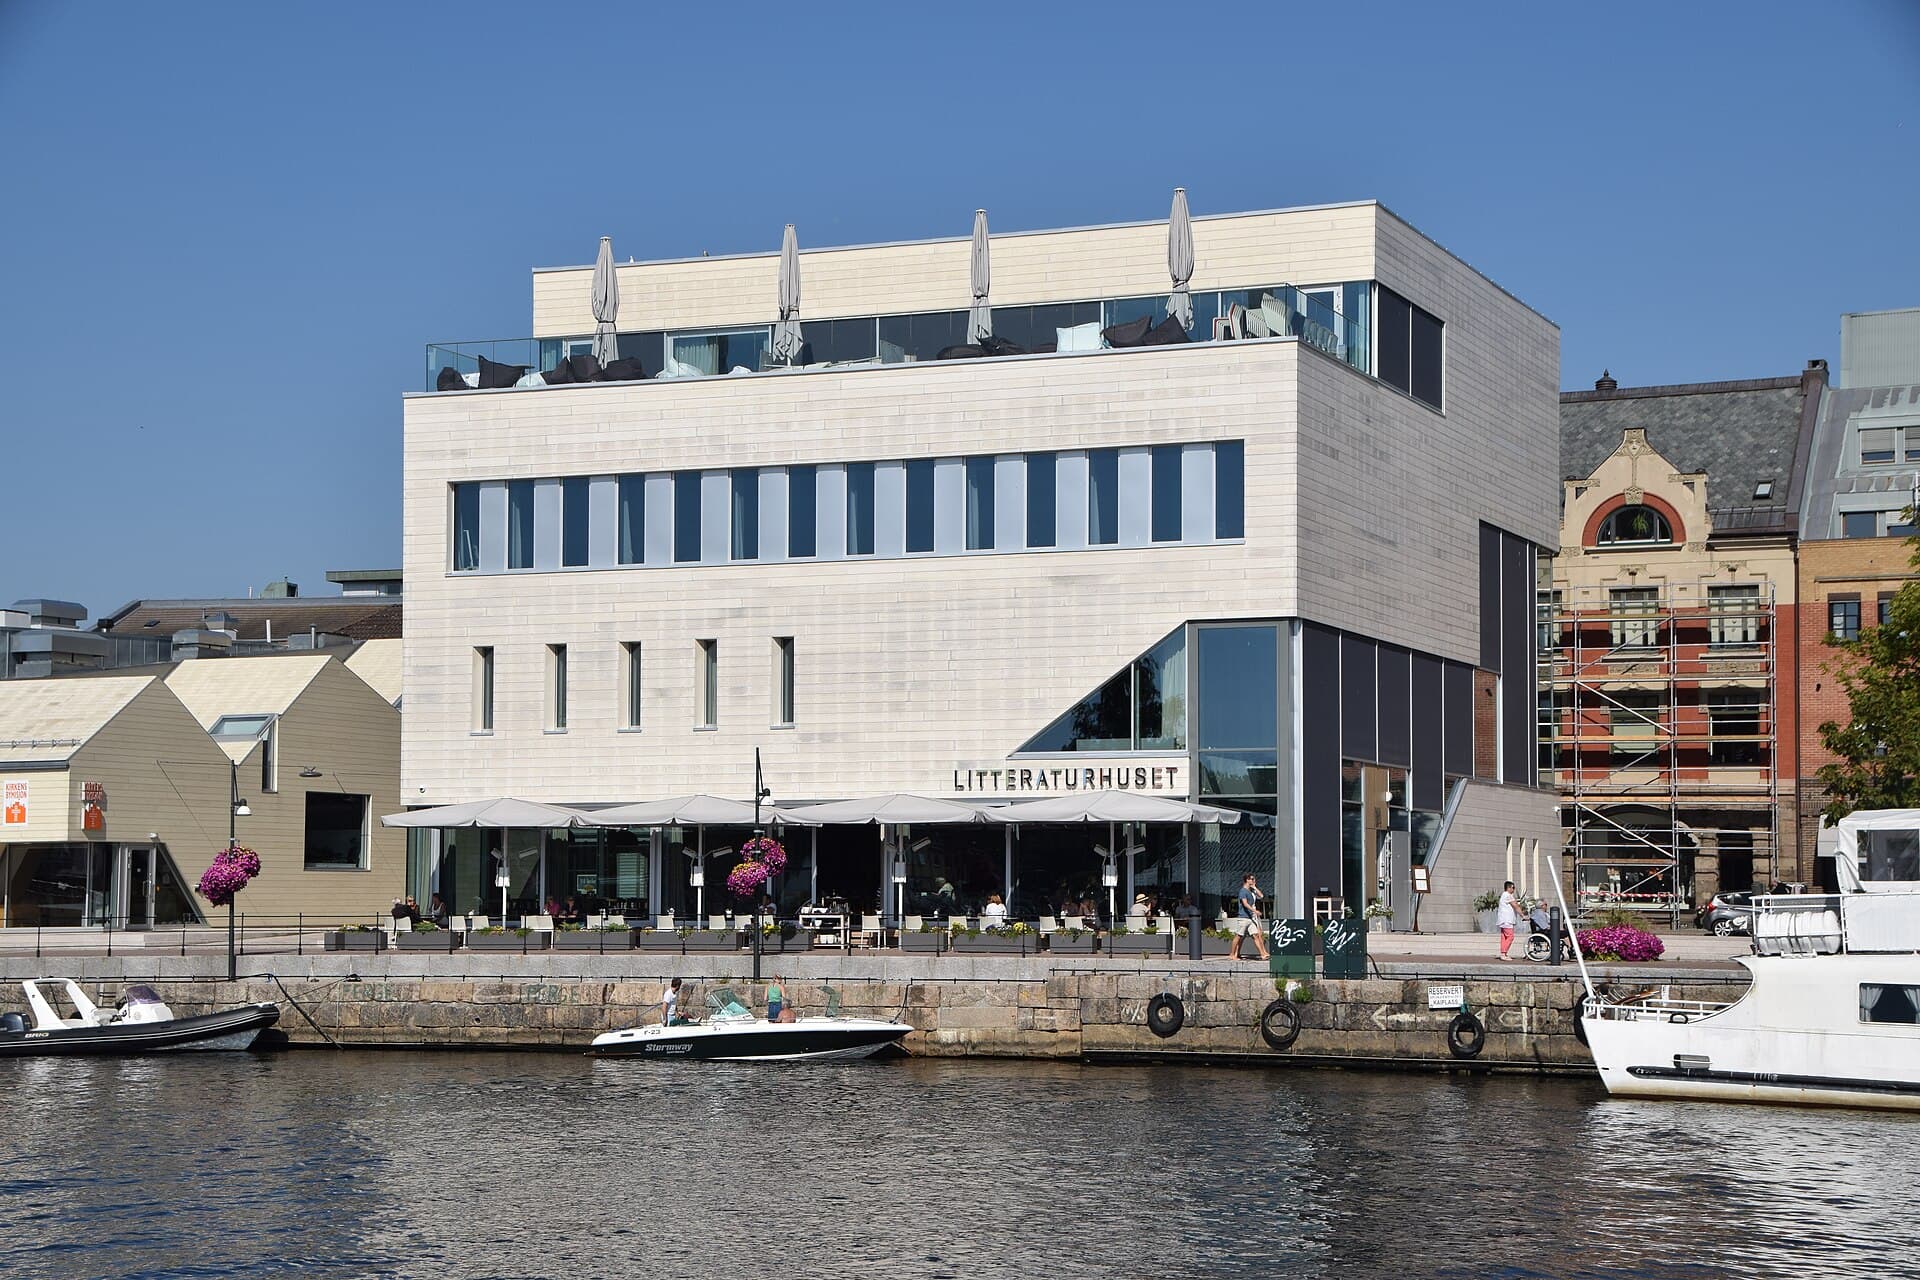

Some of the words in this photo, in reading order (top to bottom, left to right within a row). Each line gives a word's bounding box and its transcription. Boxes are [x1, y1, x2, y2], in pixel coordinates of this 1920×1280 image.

[954, 766, 1178, 791] LITTERATURHUSET
[1428, 987, 1462, 995] RESERVERT
[645, 1043, 693, 1052] Stormway
